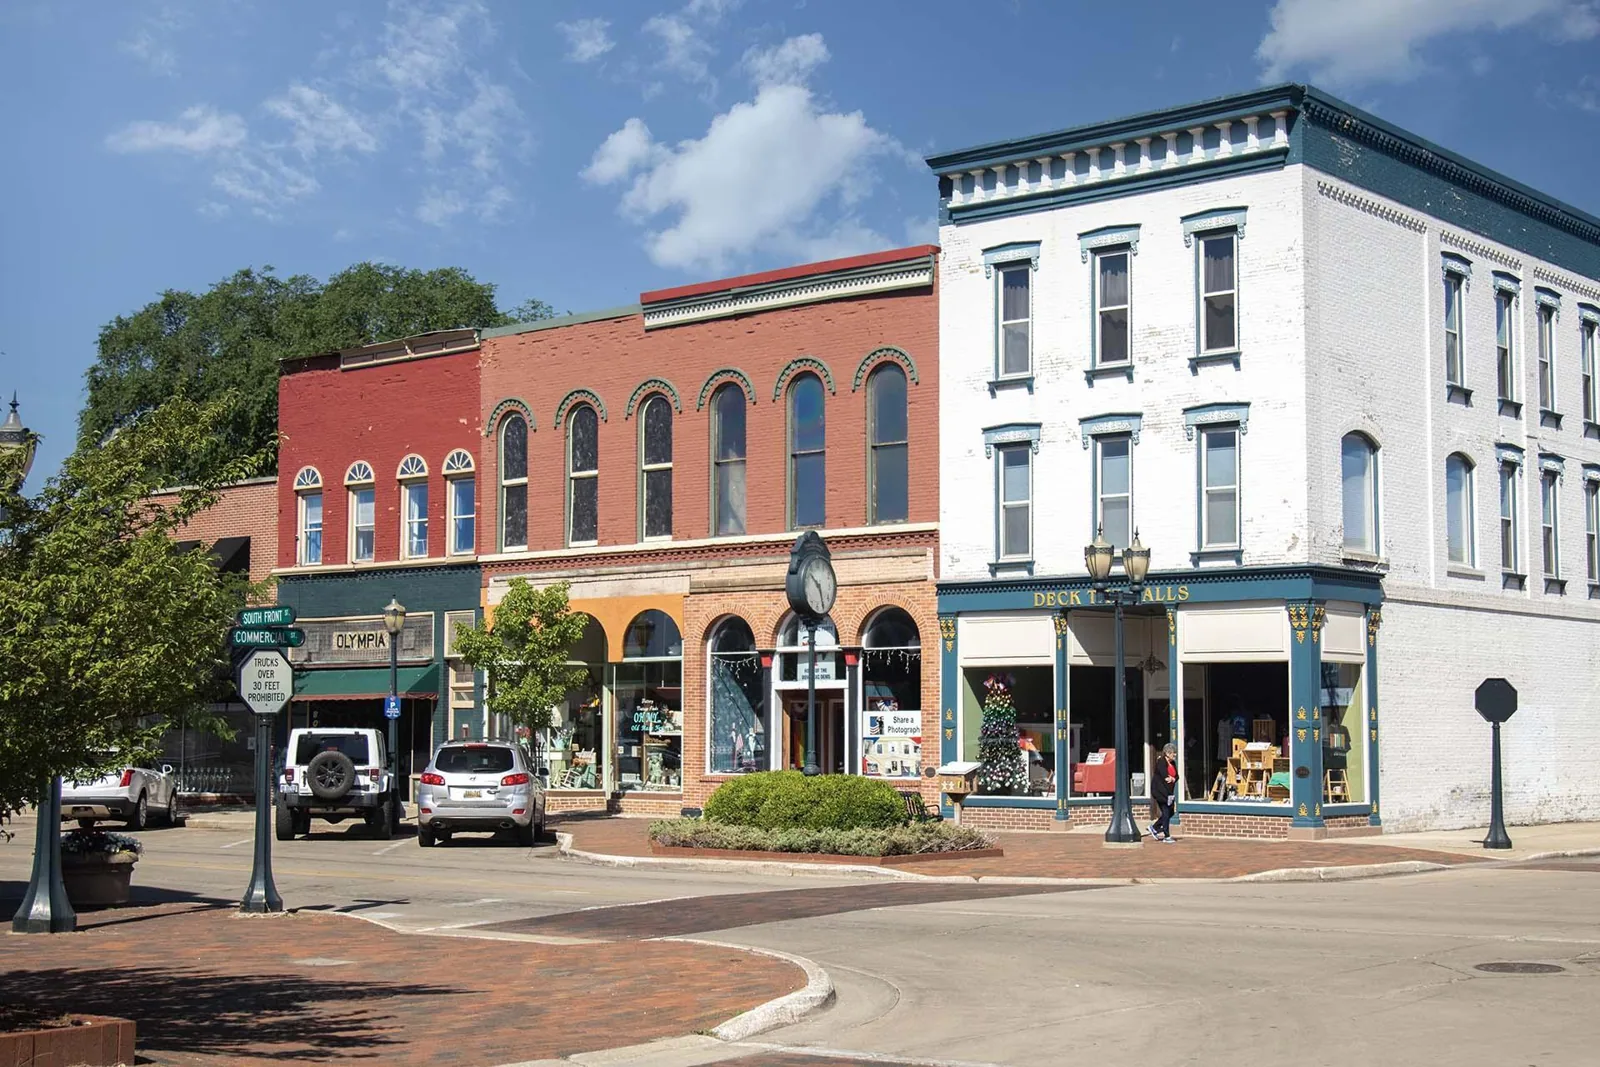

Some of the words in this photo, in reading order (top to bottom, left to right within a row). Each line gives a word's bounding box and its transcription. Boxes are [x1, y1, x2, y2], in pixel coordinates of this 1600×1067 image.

[1033, 591, 1082, 607] DECK
[1131, 585, 1190, 603] ALLS
[244, 612, 262, 625] SOUTH
[264, 610, 282, 623] FRONT
[235, 631, 287, 644] COMMERCIAL
[336, 633, 386, 649] OLYMPIA
[254, 658, 279, 667] TRUCKS
[257, 669, 275, 679] OVER
[252, 681, 262, 690] 30
[264, 681, 280, 690] FEET
[247, 692, 286, 702] PROHIBITED
[892, 716, 909, 724] Share
[887, 725, 921, 735] Photograph
